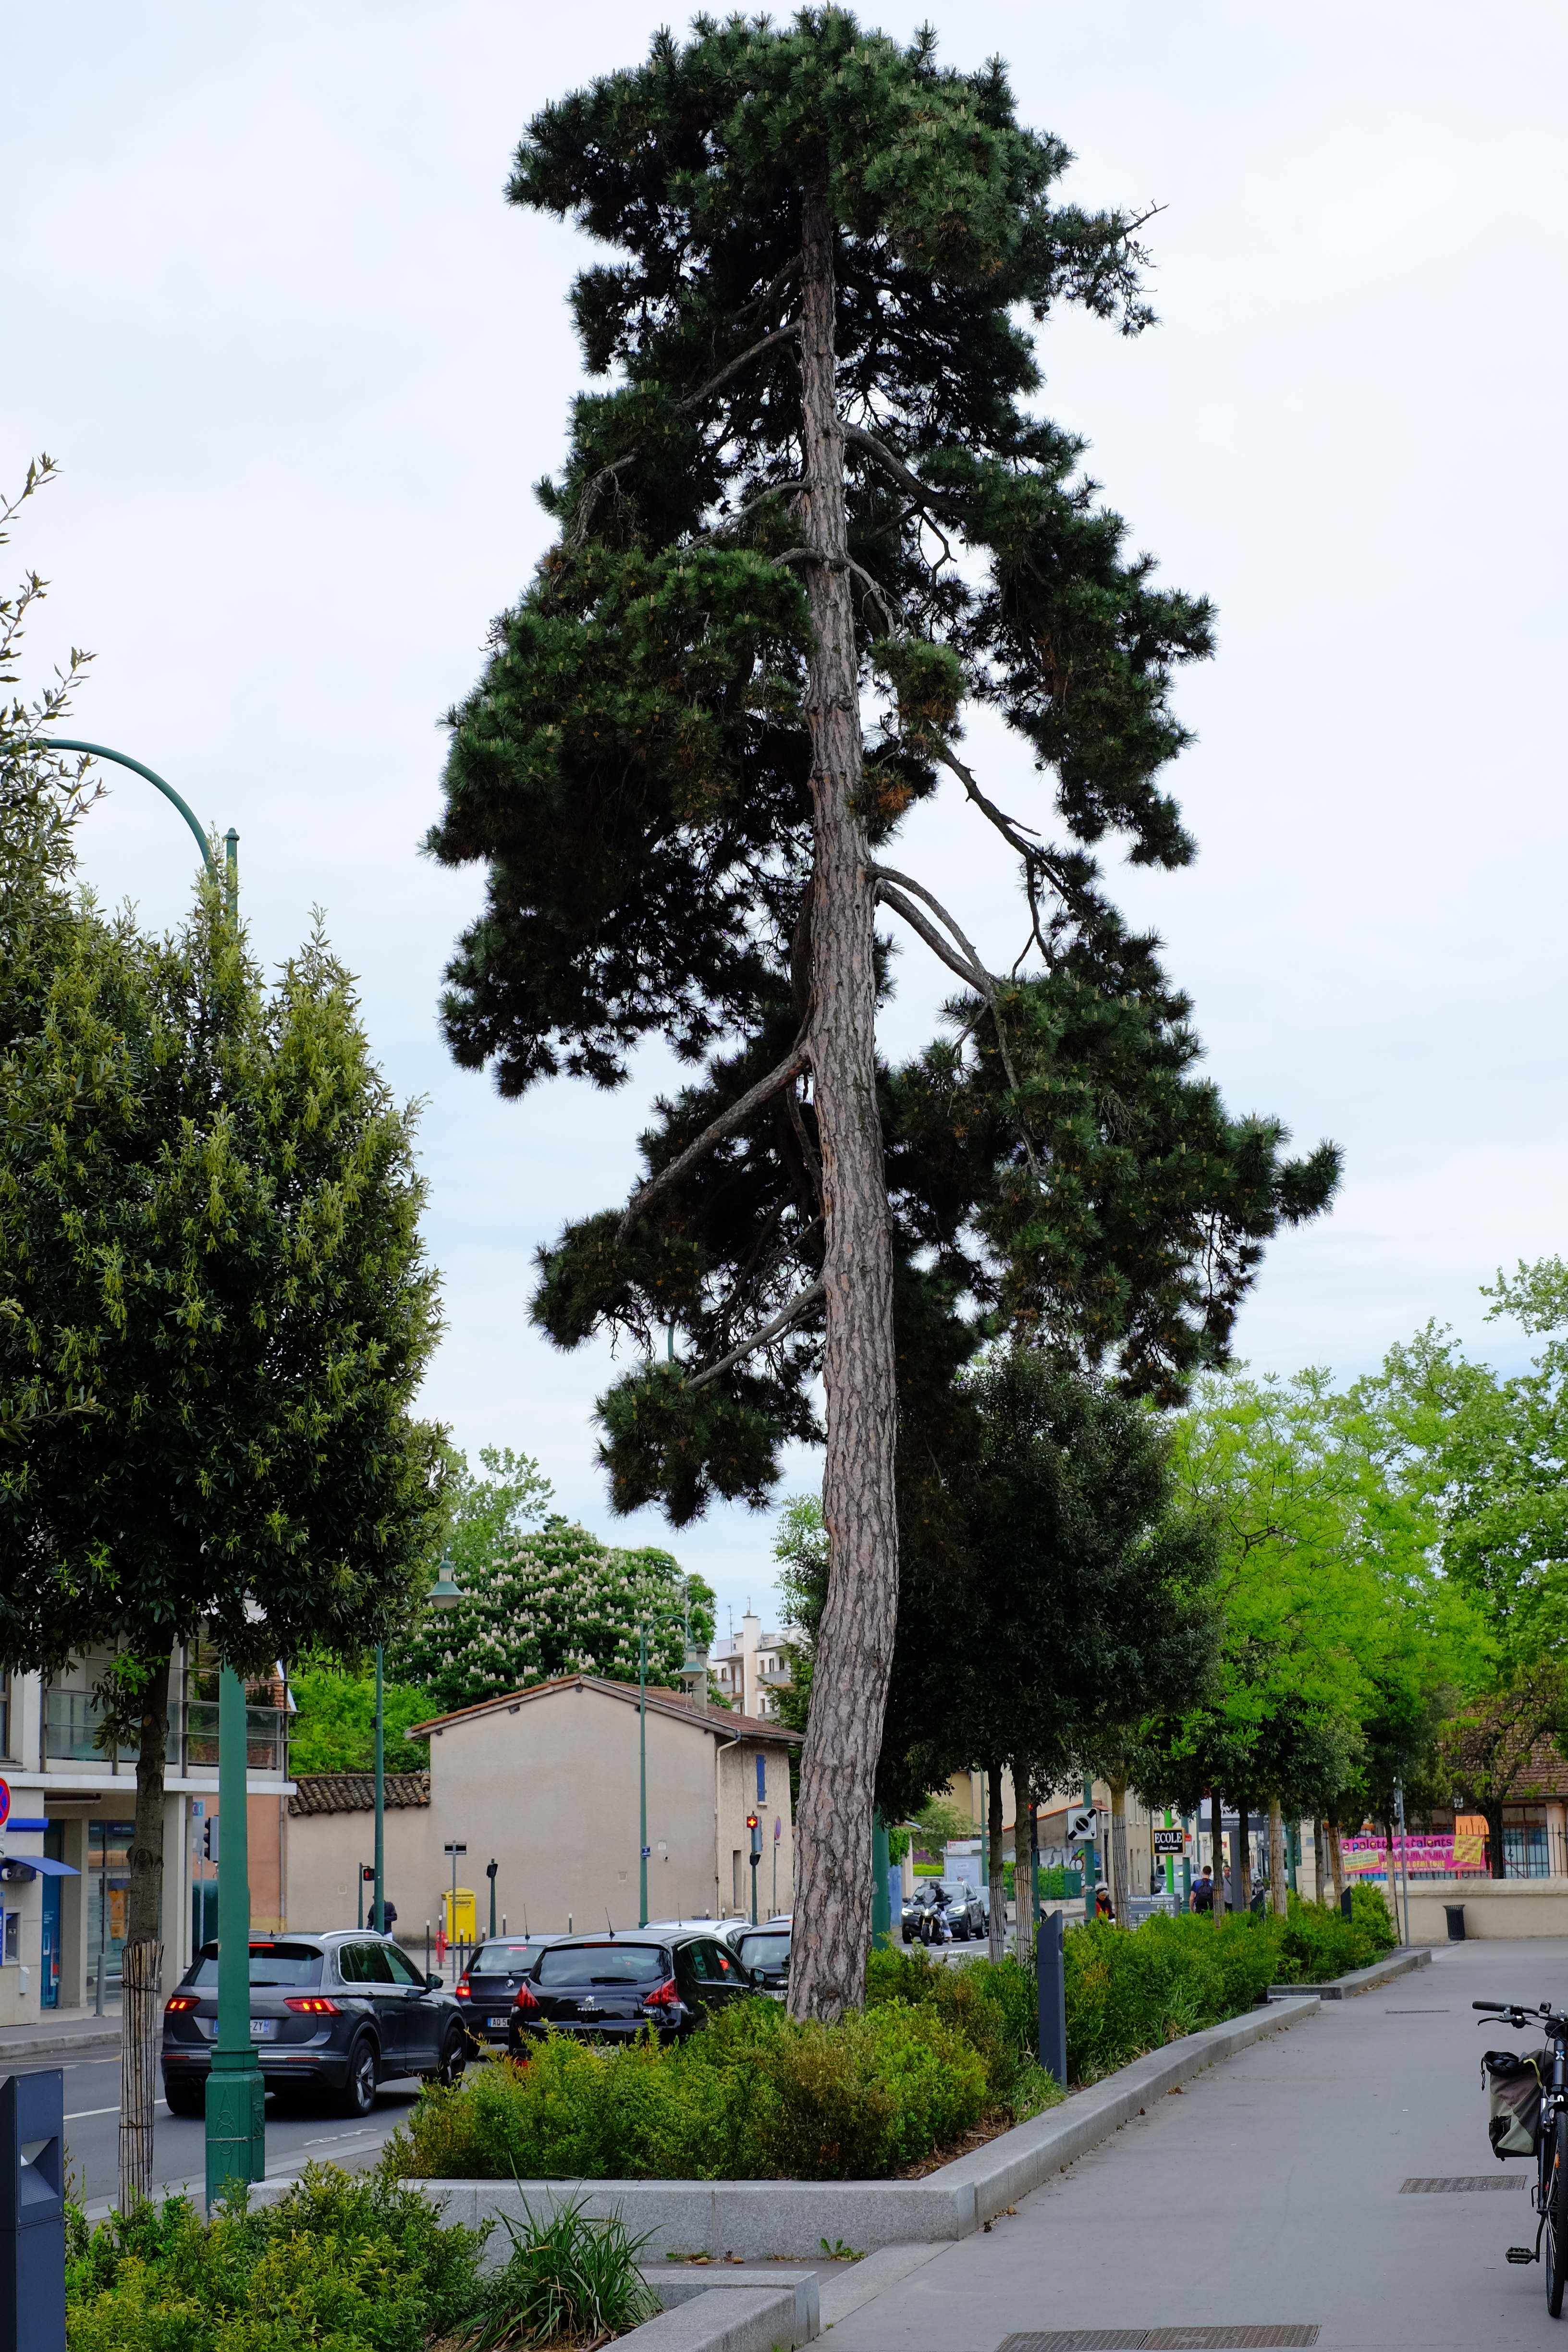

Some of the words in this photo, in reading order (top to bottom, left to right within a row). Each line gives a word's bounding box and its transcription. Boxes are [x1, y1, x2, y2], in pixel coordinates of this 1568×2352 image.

[1154, 1832, 1182, 1843] ECOLE
[1353, 1839, 1387, 1852] palett
[1411, 1837, 1452, 1847] talents
